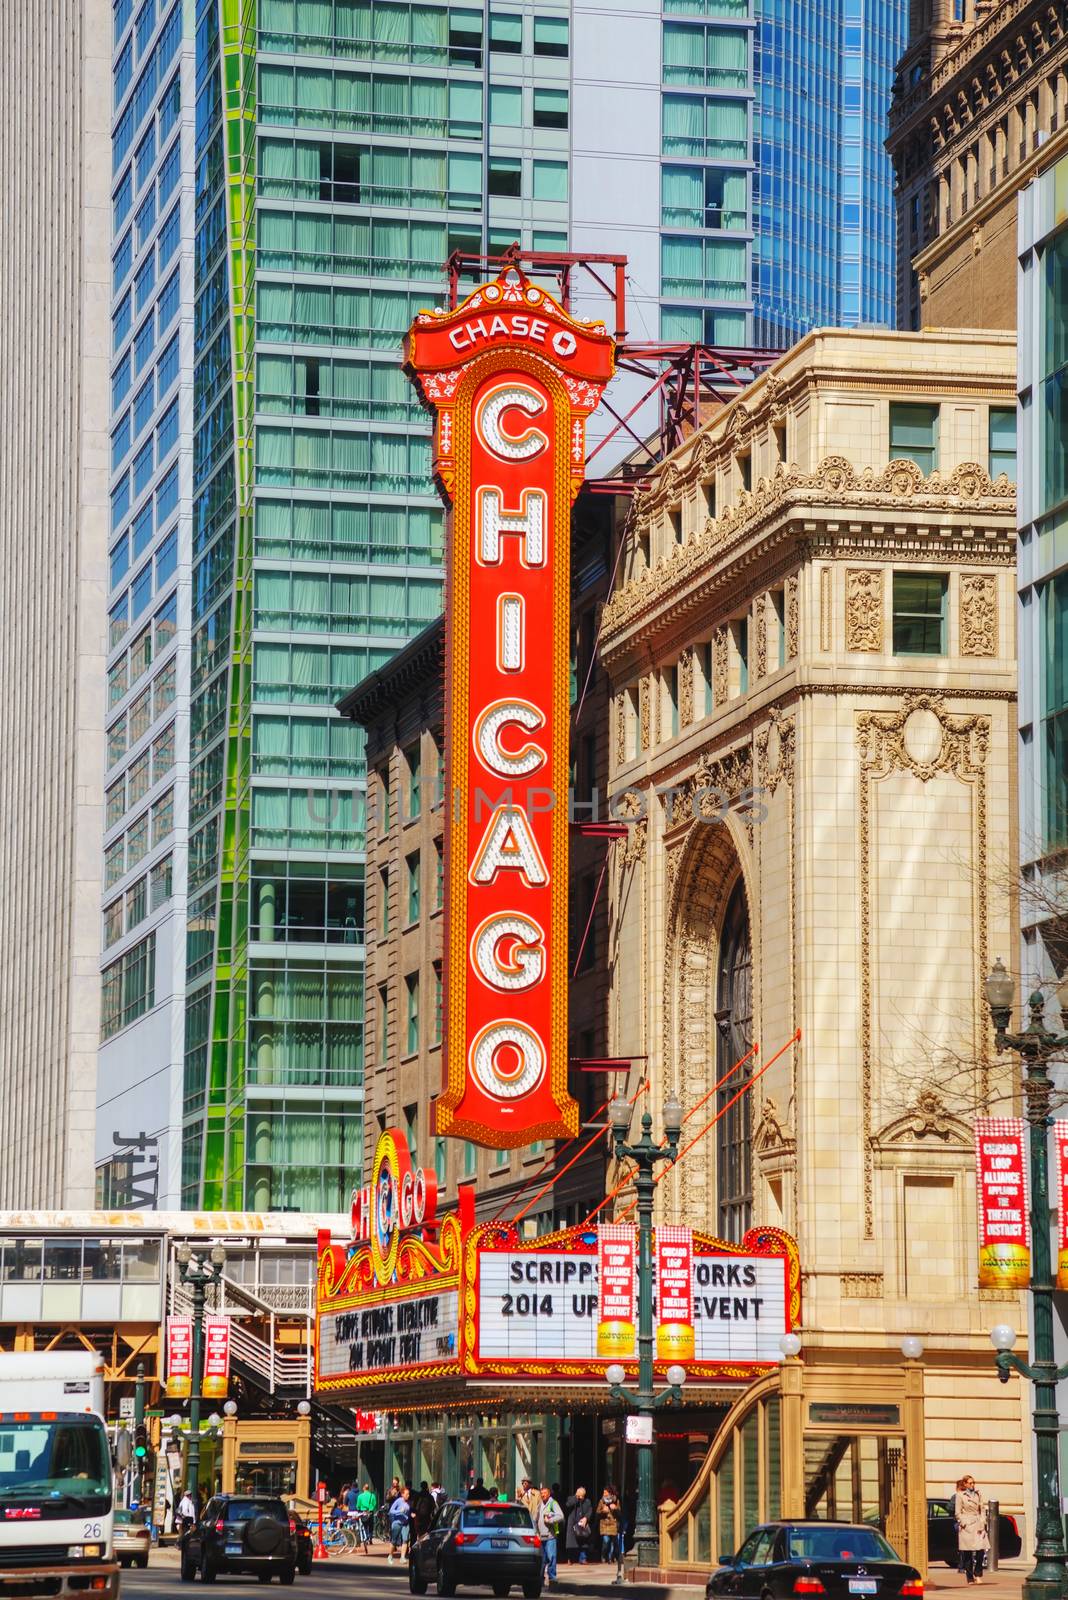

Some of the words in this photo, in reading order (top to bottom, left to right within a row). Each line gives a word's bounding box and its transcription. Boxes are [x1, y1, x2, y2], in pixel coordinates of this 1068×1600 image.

[449, 316, 549, 349] CHASE
[468, 382, 550, 1103] CHICAGO
[991, 1158, 1012, 1169] LOOP
[984, 1172, 1021, 1184] ALLIANCE
[351, 1166, 426, 1241] CHICAGO
[987, 1209, 1021, 1221] THEATRE
[986, 1224, 1022, 1236] DISTRICT
[667, 1258, 683, 1268] LOOP
[501, 1293, 553, 1317] 2014
[83, 1523, 101, 1539] 26
